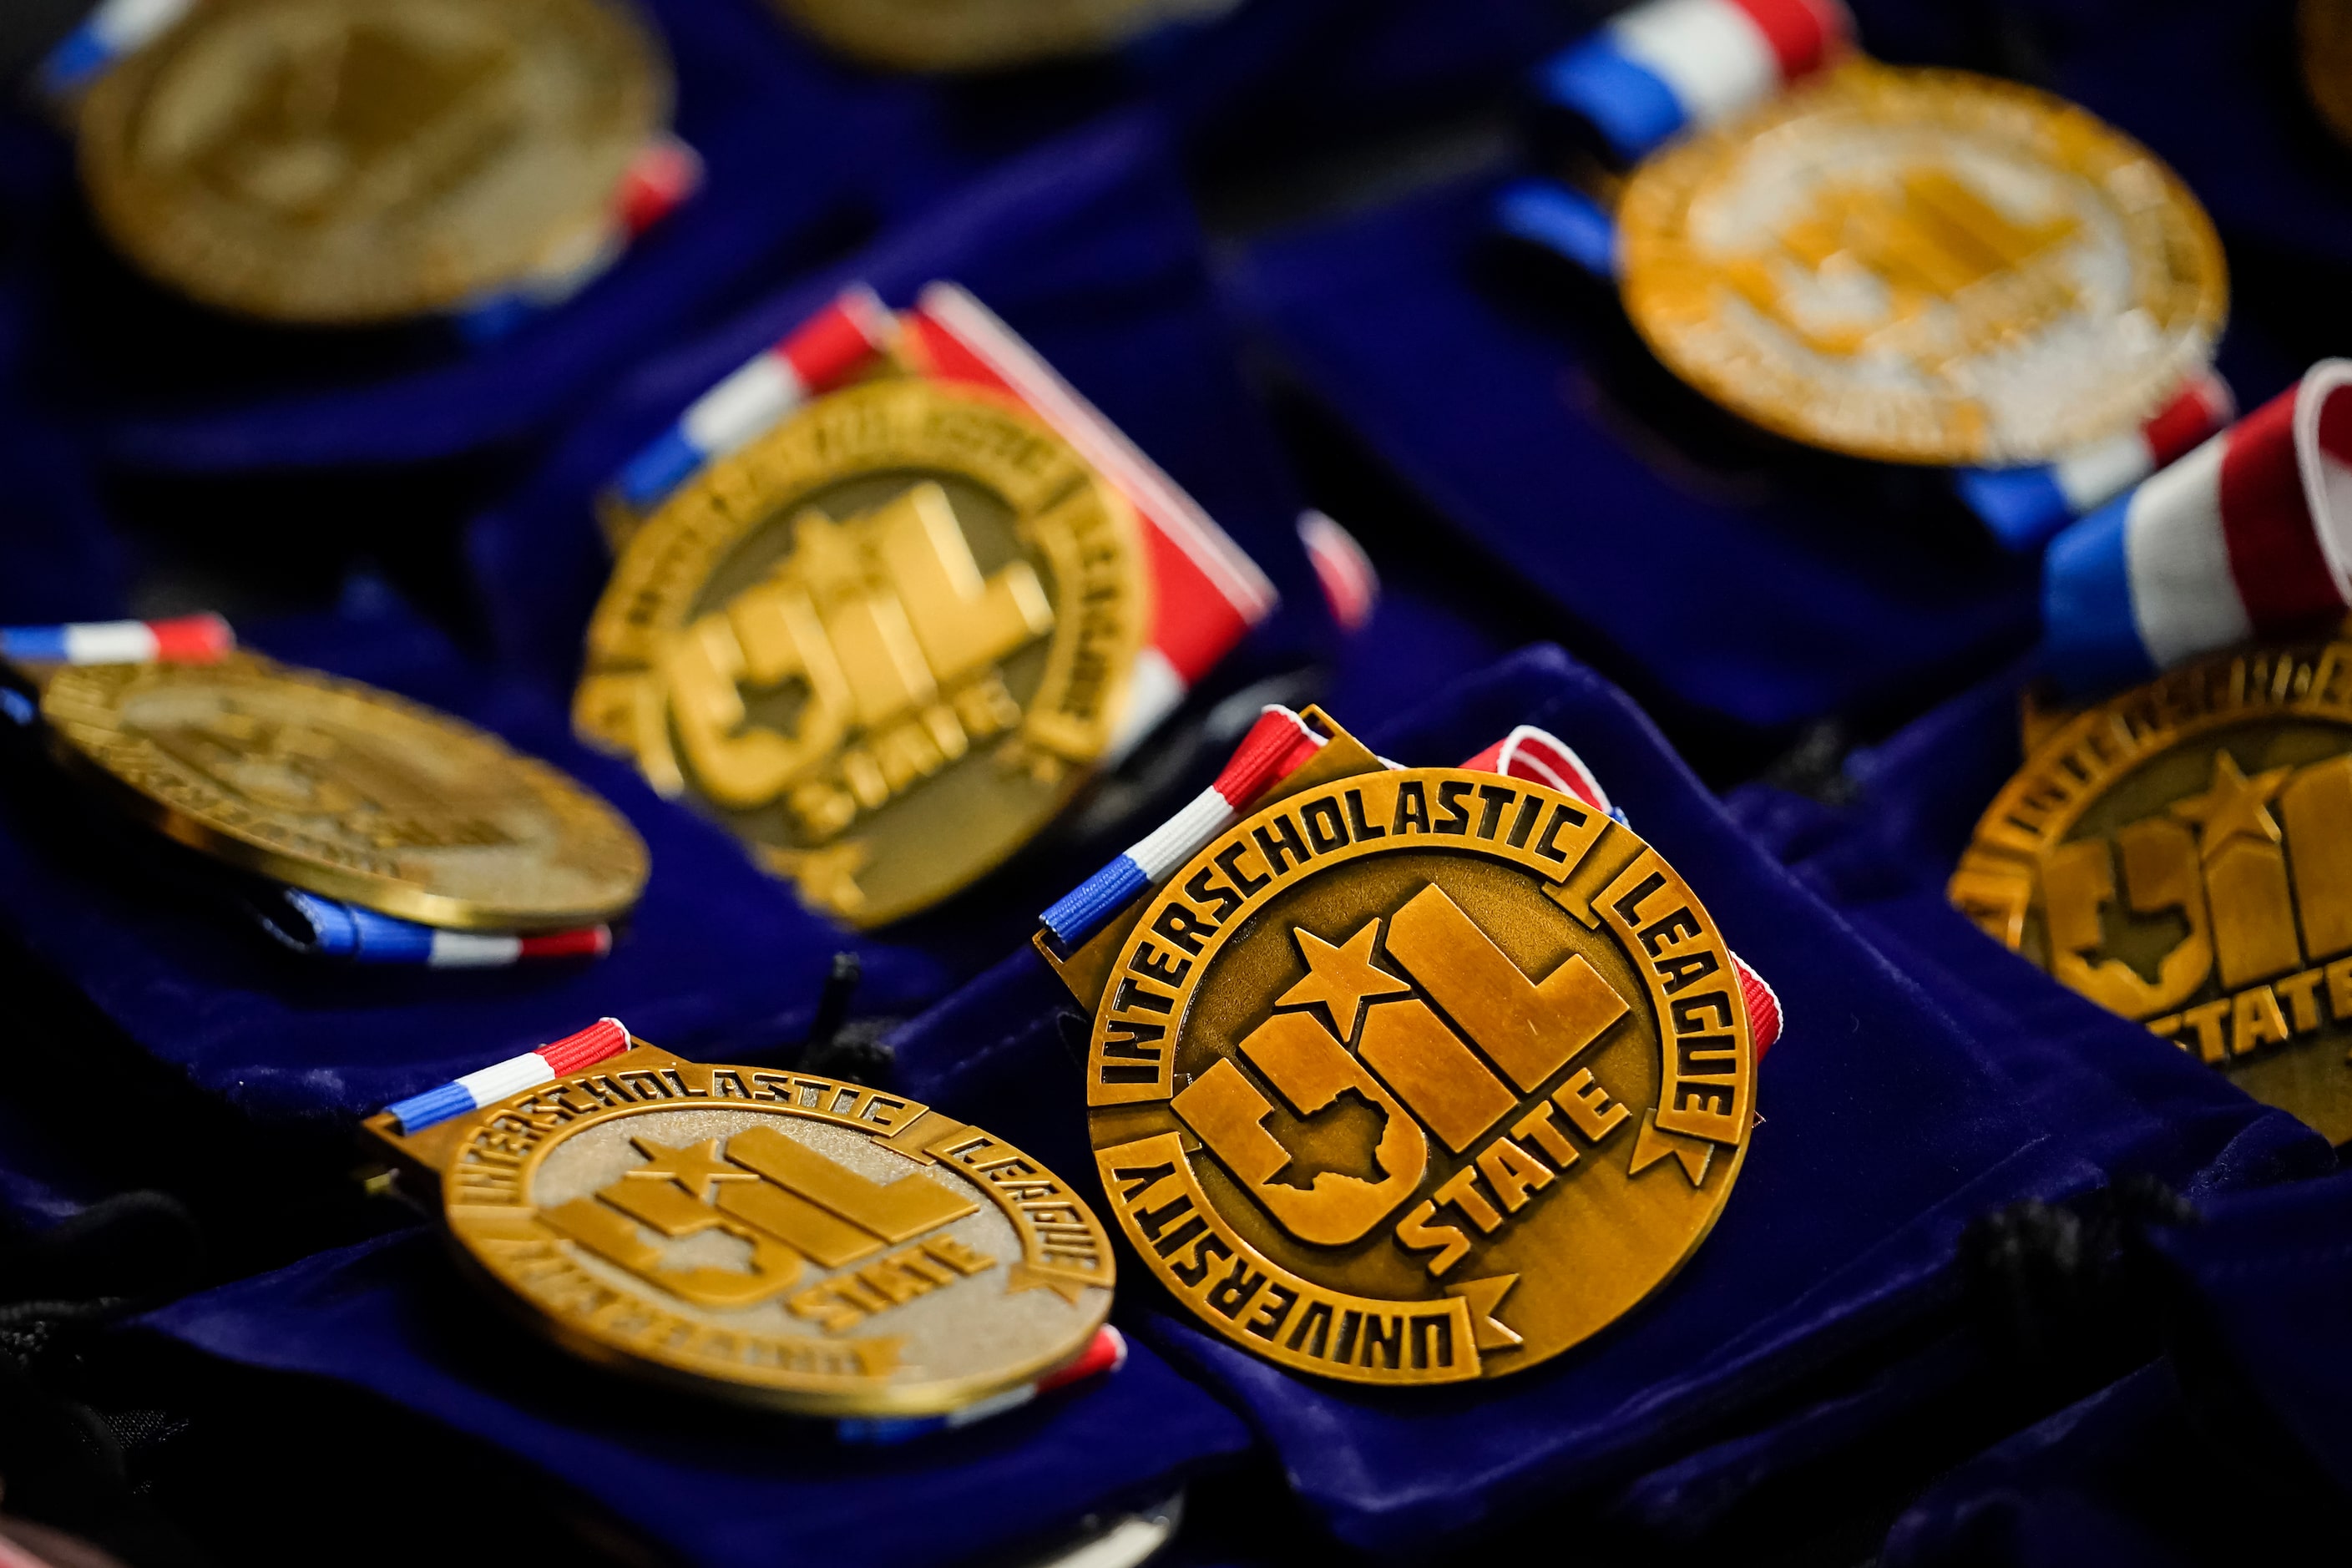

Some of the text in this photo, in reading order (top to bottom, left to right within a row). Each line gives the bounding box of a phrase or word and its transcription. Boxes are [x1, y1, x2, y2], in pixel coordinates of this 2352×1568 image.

[1099, 780, 1588, 1085] INTERSCHOLASTIC
[1612, 870, 1738, 1117] LEAGUE
[1171, 883, 1631, 1247] UIL
[539, 1125, 981, 1308] UIL
[946, 1137, 1101, 1271] LEAGUE
[1113, 1166, 1453, 1370] UNIVERSITY
[1395, 1068, 1632, 1277] STATE
[785, 1233, 999, 1331] STATE
